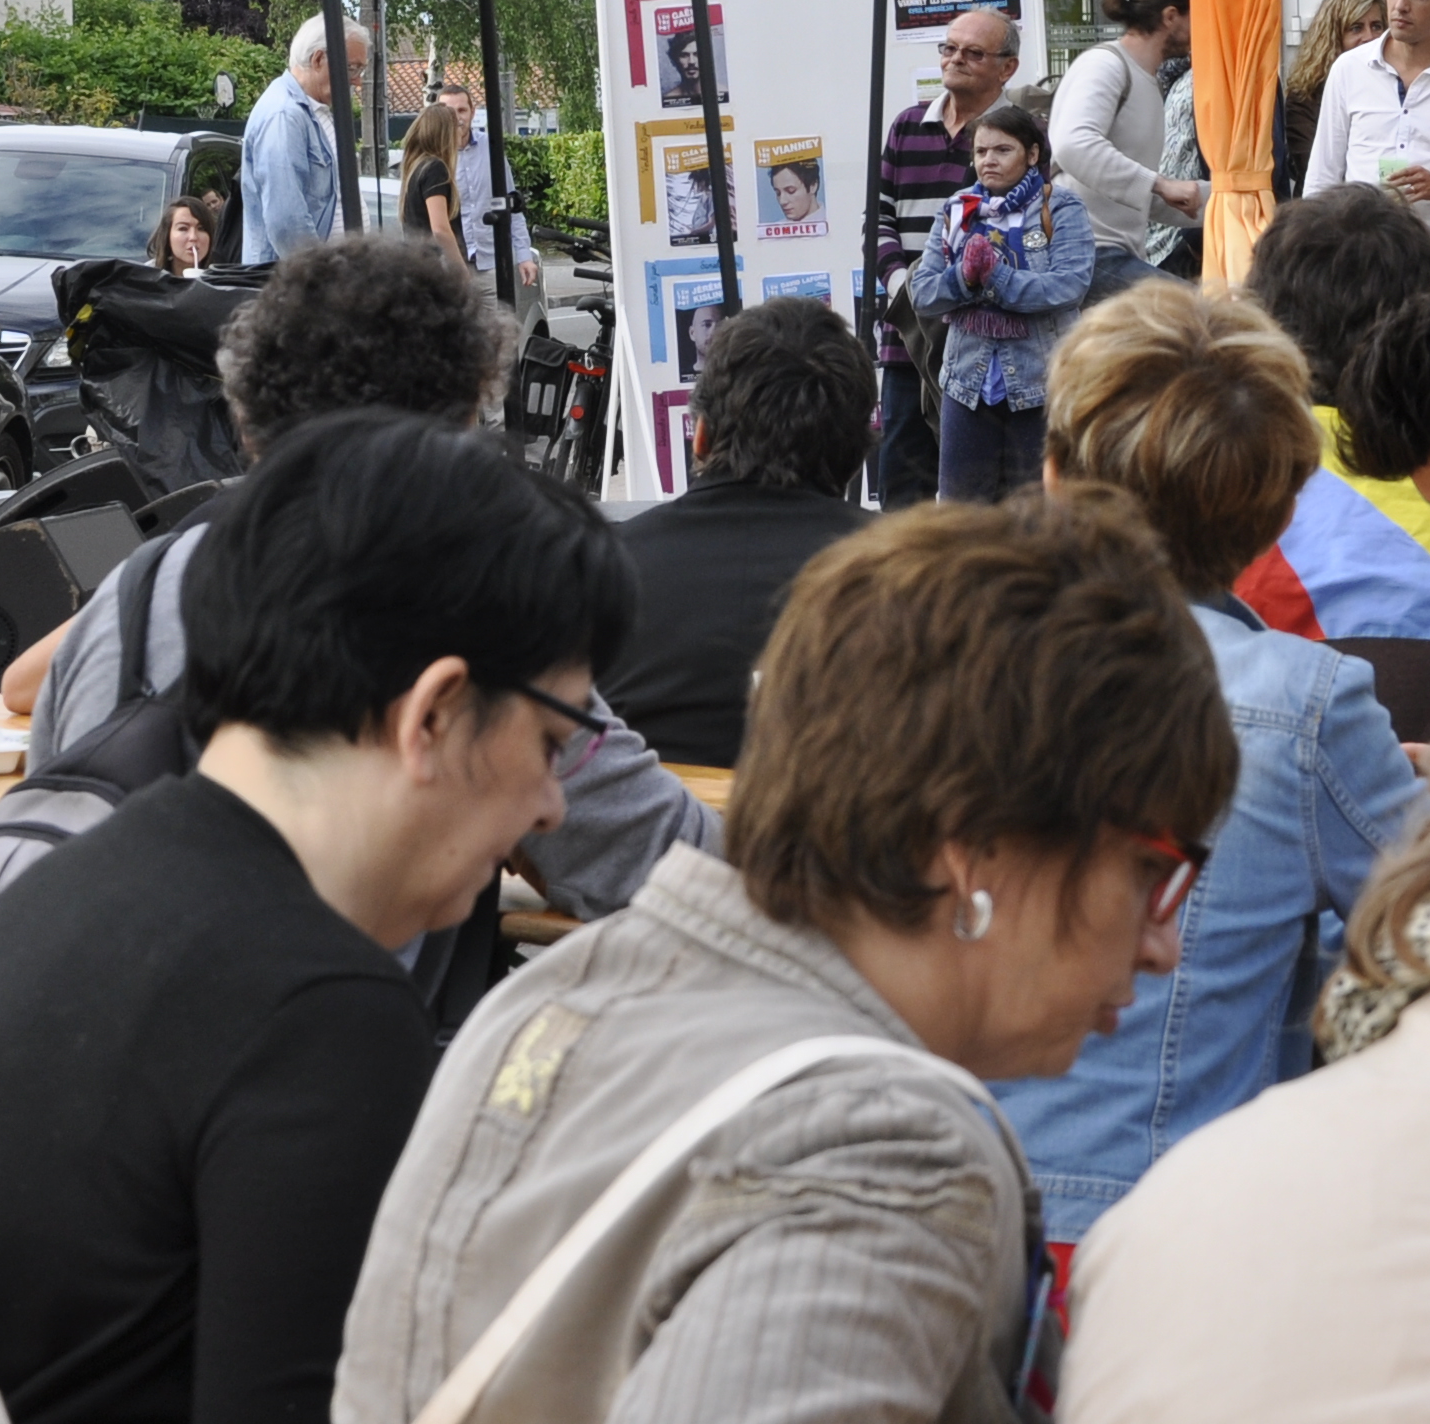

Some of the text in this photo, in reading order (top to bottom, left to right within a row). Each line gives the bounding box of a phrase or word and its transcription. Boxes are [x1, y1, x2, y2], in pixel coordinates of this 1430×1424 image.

[673, 17, 694, 28] FAU
[772, 138, 820, 156] VIANNEY
[765, 225, 818, 237] COMPLET
[692, 282, 722, 294] JÉRÉM
[693, 291, 724, 303] KISLIN
